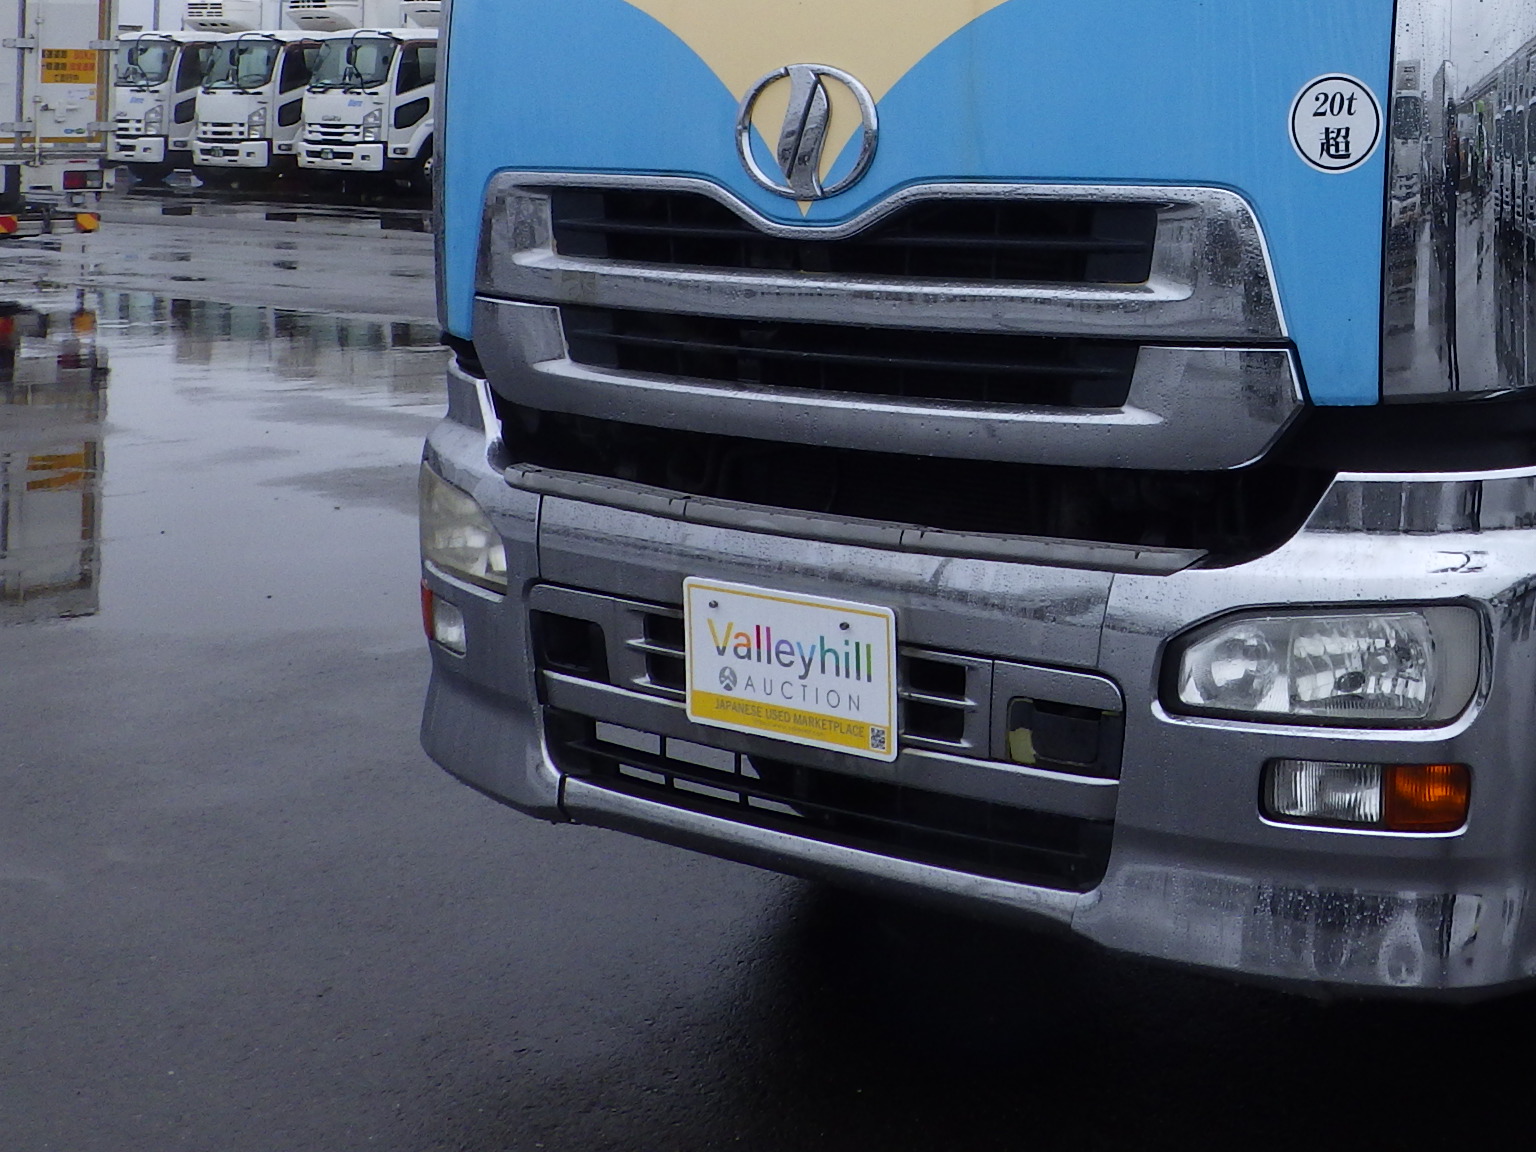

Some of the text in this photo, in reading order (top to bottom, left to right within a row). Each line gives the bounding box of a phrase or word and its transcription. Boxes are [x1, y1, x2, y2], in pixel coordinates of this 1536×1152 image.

[1312, 91, 1358, 117] 20t
[1318, 126, 1352, 160] 超
[707, 618, 872, 683] Valleyhill
[744, 676, 860, 711] AUCTION
[714, 699, 762, 718] JAPANESE
[765, 709, 791, 723] USED
[793, 714, 864, 737] MARKETPLACE
